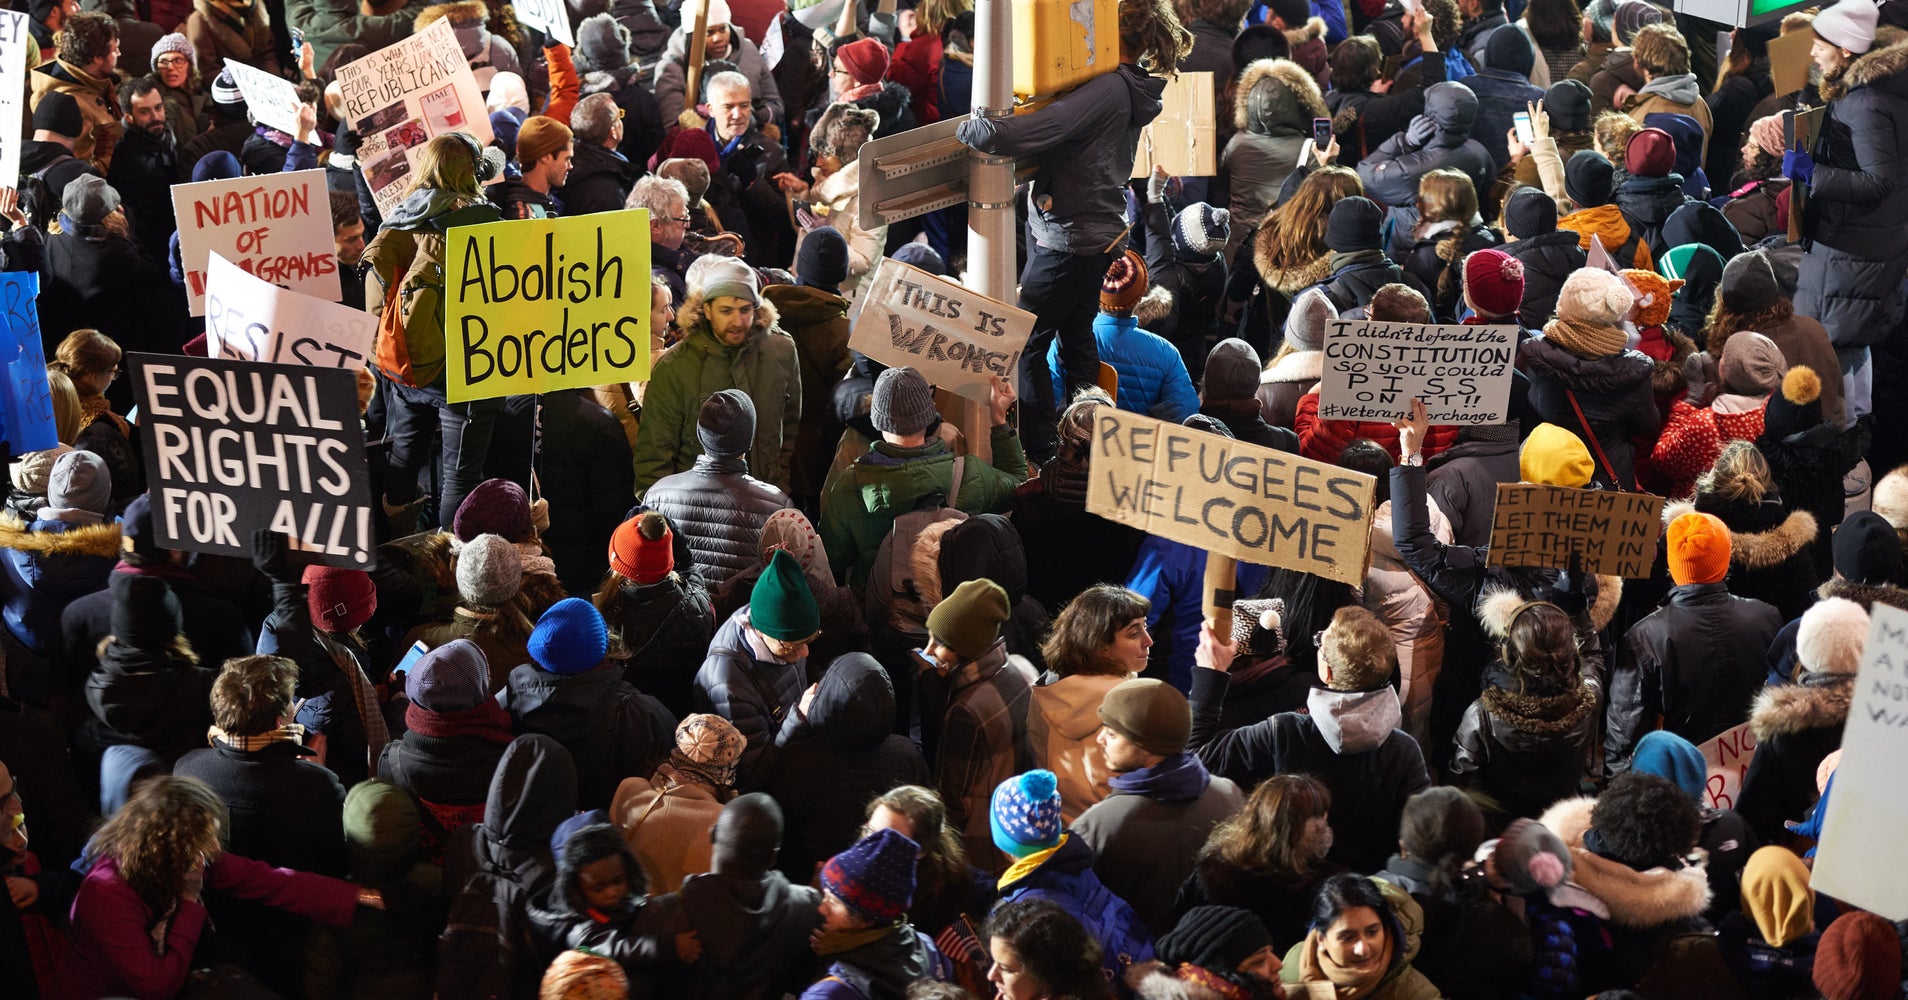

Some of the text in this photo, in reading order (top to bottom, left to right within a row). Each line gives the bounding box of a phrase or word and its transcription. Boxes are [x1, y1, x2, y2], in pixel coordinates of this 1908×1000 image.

[339, 21, 450, 83] THIS IS WHAT THE NEXT
[340, 76, 372, 100] FOUR
[376, 57, 411, 83] YEARS
[426, 88, 450, 104] TIME
[194, 183, 310, 229] NATION
[375, 180, 403, 203] UNLESS
[236, 227, 270, 255] OF
[459, 226, 623, 304] Abolish
[897, 279, 1007, 337] THIS IS
[209, 294, 362, 368] RESIST
[461, 307, 638, 386] Borders
[888, 314, 1021, 383] WRONG!
[1329, 322, 1508, 346] I didn't defend the
[1326, 342, 1511, 365] CONSTITUTION
[1434, 364, 1506, 378] could
[142, 364, 343, 431] EQUAL
[1348, 373, 1478, 396] PISS
[1356, 391, 1482, 409] ON IT!!
[1322, 403, 1500, 425] #veteransorchange
[153, 423, 350, 496] RIGHTS
[1100, 416, 1363, 521] REFUGEES
[1108, 470, 1340, 564] WELCOME
[1498, 488, 1655, 514] LET THEM IN
[162, 487, 371, 564] FOR ALL!
[1494, 511, 1648, 538] LET THEM IN
[1491, 532, 1645, 558] LET THEM IN
[1489, 551, 1532, 567] LET
[1616, 560, 1642, 577] IN
